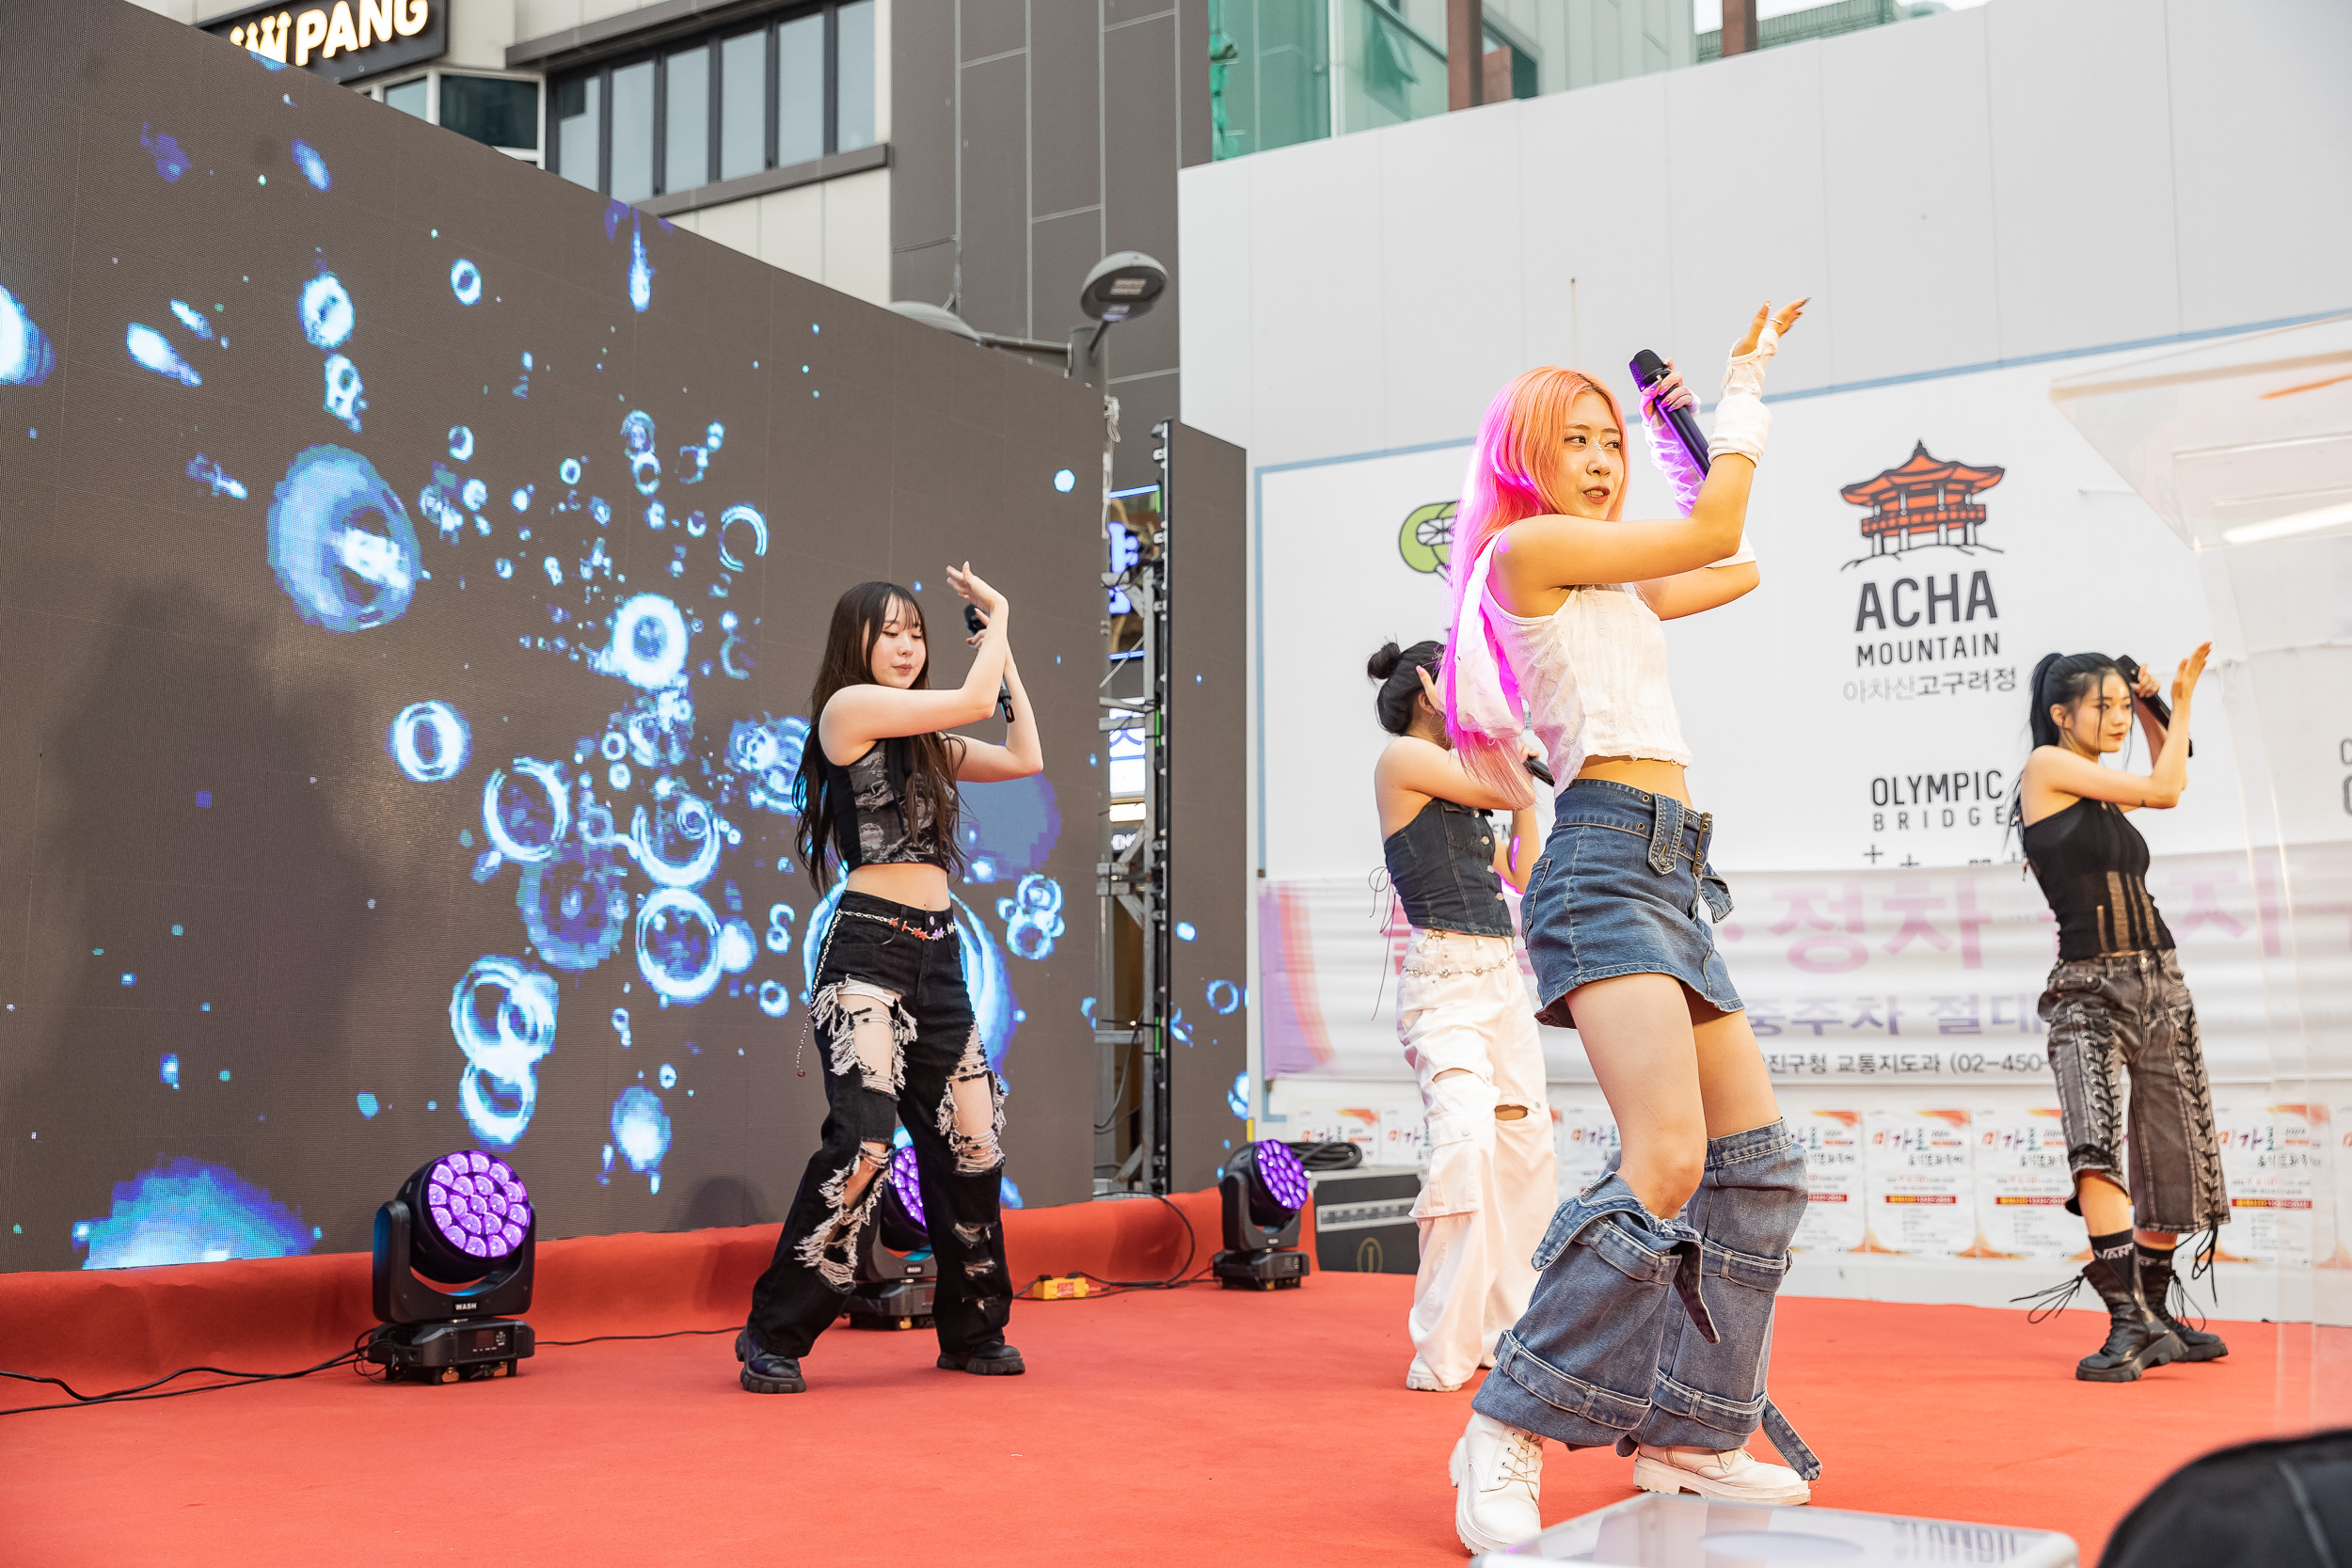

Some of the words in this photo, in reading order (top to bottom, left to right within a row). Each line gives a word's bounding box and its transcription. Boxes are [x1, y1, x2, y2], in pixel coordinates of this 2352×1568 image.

[1855, 570, 1998, 632] ACHA
[1857, 632, 2000, 668] MOUNTAIN
[1871, 769, 2003, 807] OLYMPIC
[1872, 804, 2006, 832] BRIDGE
[1761, 1052, 1827, 1076] 진구청
[1836, 1052, 1941, 1076] 교통지도과
